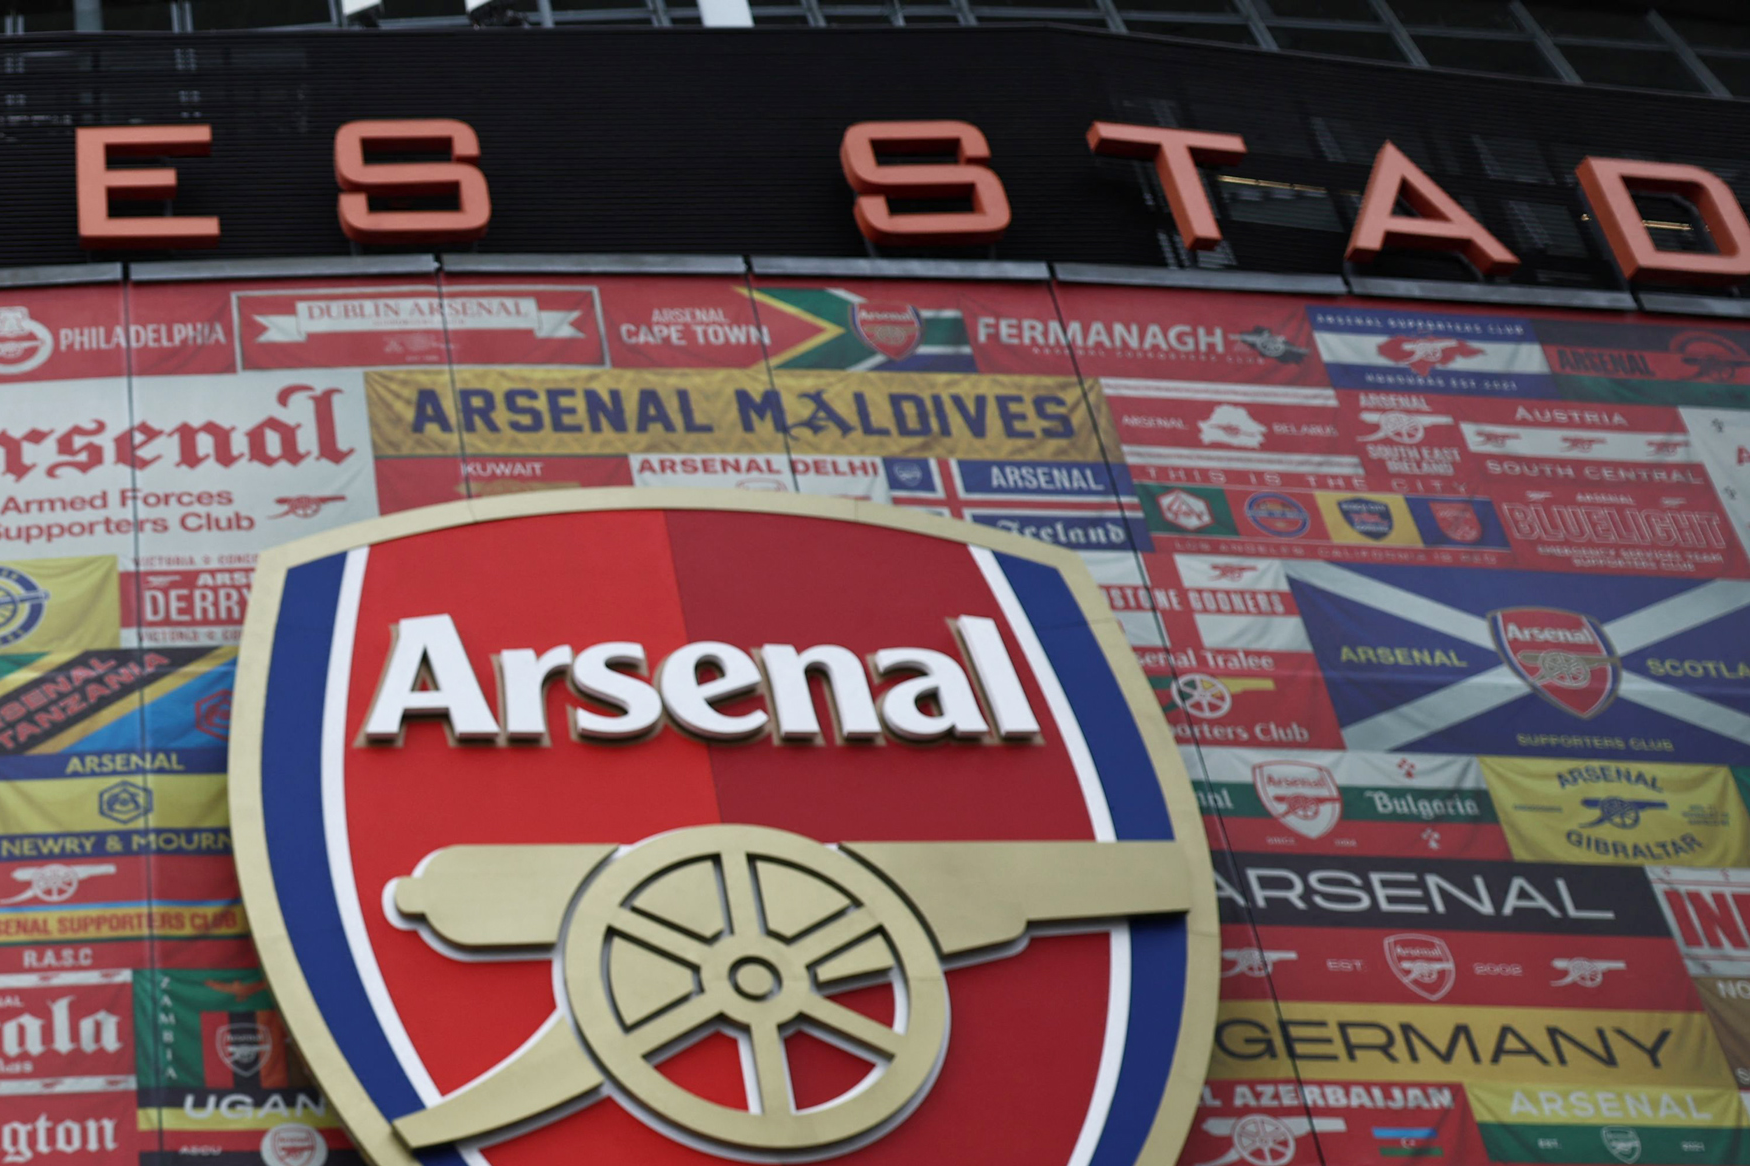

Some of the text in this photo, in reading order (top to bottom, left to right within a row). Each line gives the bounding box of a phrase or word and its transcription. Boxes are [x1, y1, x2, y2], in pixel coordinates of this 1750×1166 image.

[59, 322, 226, 352] PHILADELPHIA
[620, 325, 772, 346] CAPE TOWN
[977, 317, 1226, 354] FERMANAGH
[412, 388, 1076, 442] ARSENAL MALDIVES
[1514, 406, 1629, 427] AUSTRIA
[462, 462, 543, 477] KUWAIT
[637, 459, 879, 477] ARSENAL DELHI
[991, 466, 1104, 491] ARSENAL
[1486, 460, 1705, 485] SOUTH CENTRAL
[0, 488, 233, 516] Armed Forces
[180, 511, 255, 532] Club
[1503, 500, 1728, 551] BLUELIGHT
[1340, 647, 1467, 668] ARSENAL
[362, 612, 1043, 742] Arsenal
[65, 753, 185, 773] ARSENAL
[1556, 766, 1662, 792] ARSENAL
[1, 832, 234, 858] NEWRY & MOURN
[1566, 829, 1704, 860] GIBRALTAR
[1212, 866, 1615, 920] ARSENAL
[58, 912, 185, 934] SUPPORTERS
[191, 911, 237, 932] CLUB
[1216, 1018, 1672, 1069] GERMANY
[1234, 1084, 1455, 1110] AZERBAIJAN
[1510, 1090, 1712, 1120] ARSENAL
